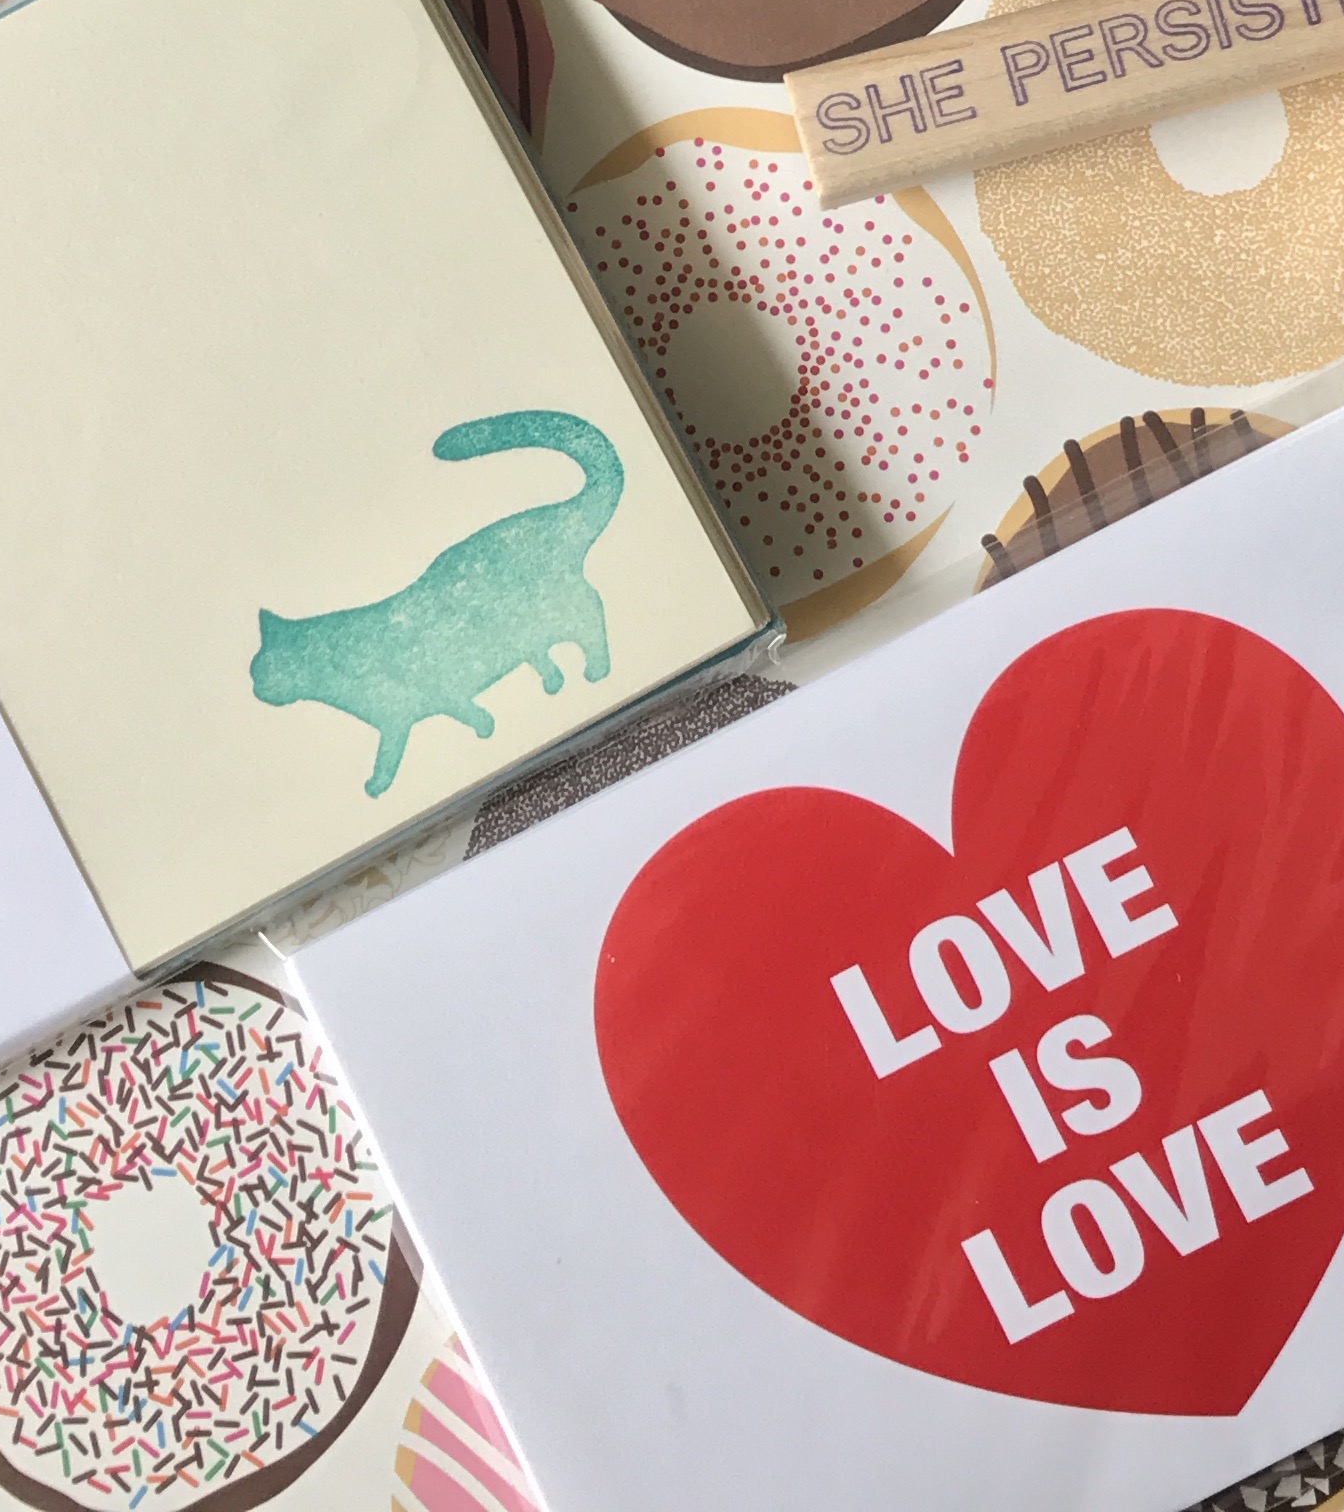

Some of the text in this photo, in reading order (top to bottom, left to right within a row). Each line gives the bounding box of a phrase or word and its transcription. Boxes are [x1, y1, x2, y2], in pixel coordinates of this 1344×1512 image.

[815, 57, 978, 157] SHE
[829, 825, 1180, 1079] LOVE
[991, 1014, 1142, 1164] IS
[961, 1088, 1315, 1345] LOVE
